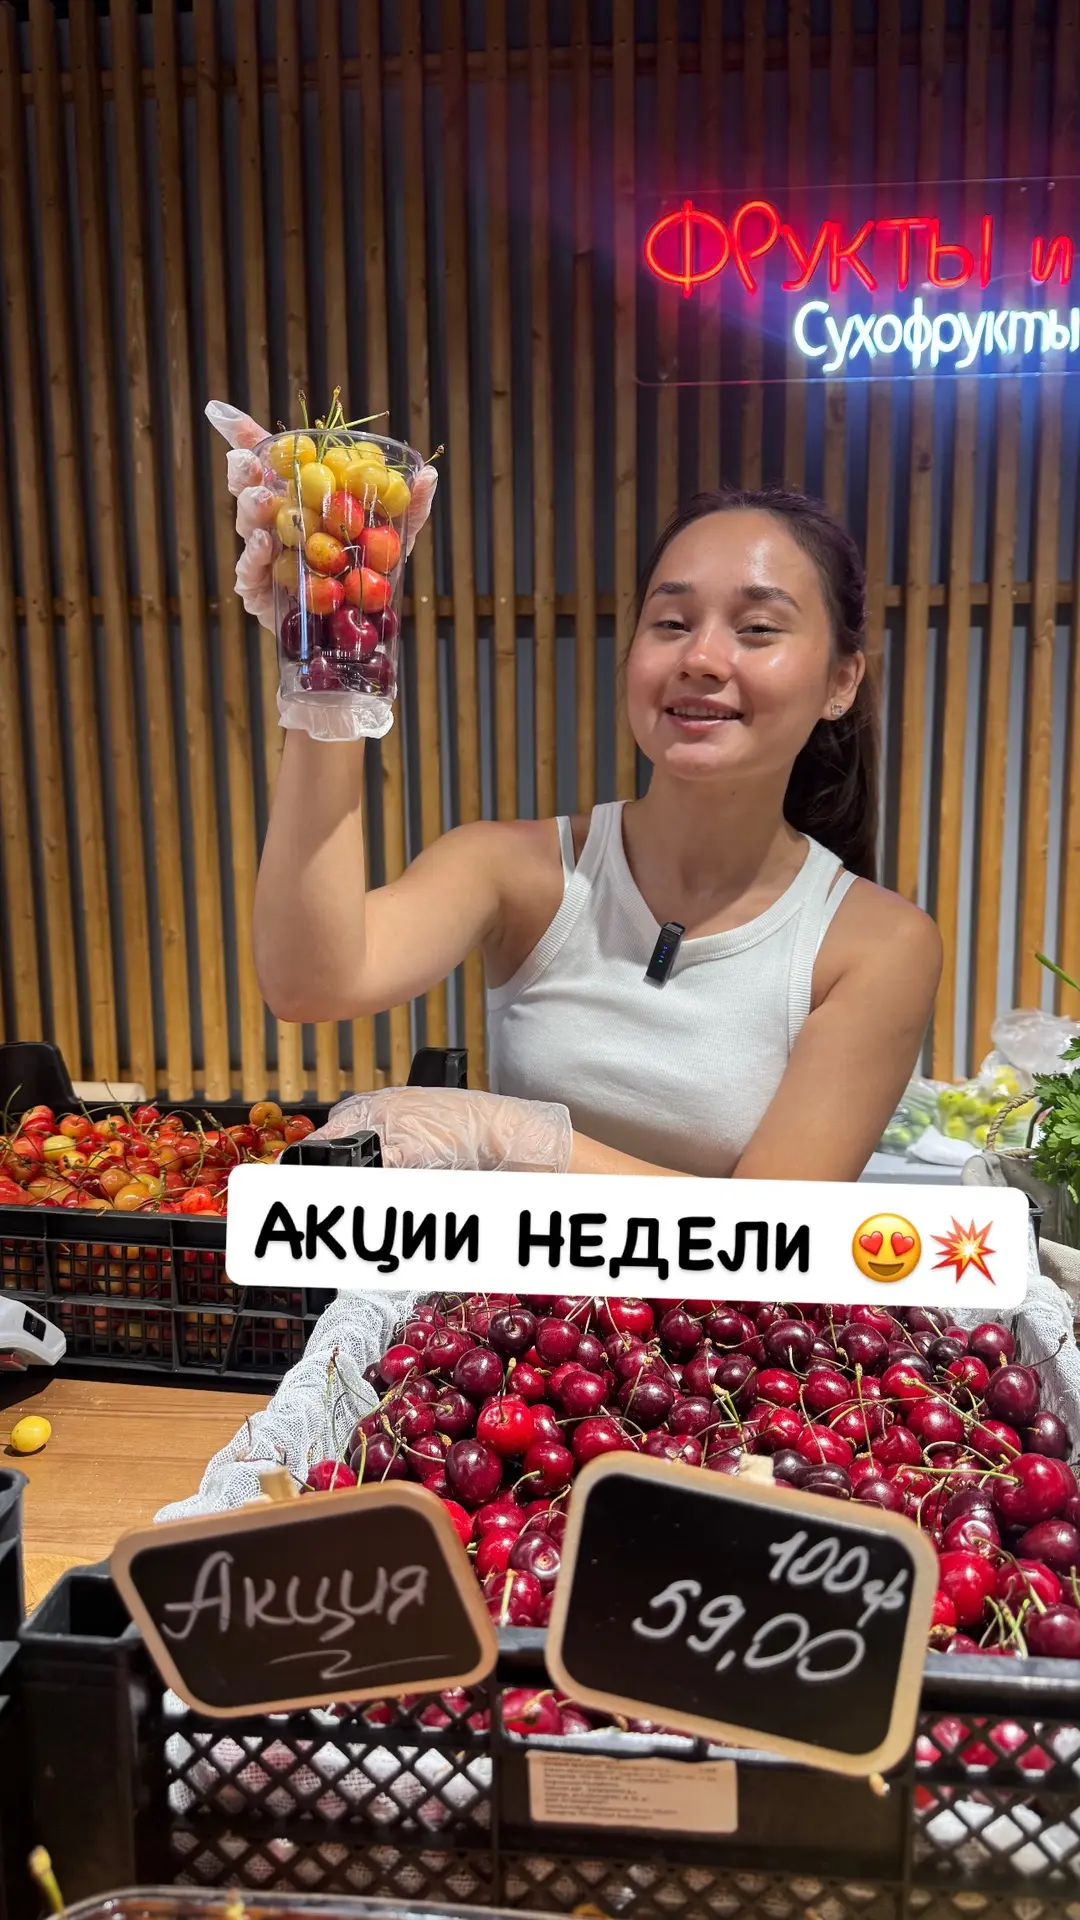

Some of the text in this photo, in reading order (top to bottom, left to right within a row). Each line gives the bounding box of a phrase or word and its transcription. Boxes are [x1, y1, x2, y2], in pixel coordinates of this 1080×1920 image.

[793, 296, 1080, 374] Сухофрукты
[161, 1549, 429, 1643] Акция
[631, 1578, 867, 1682] 59,00
